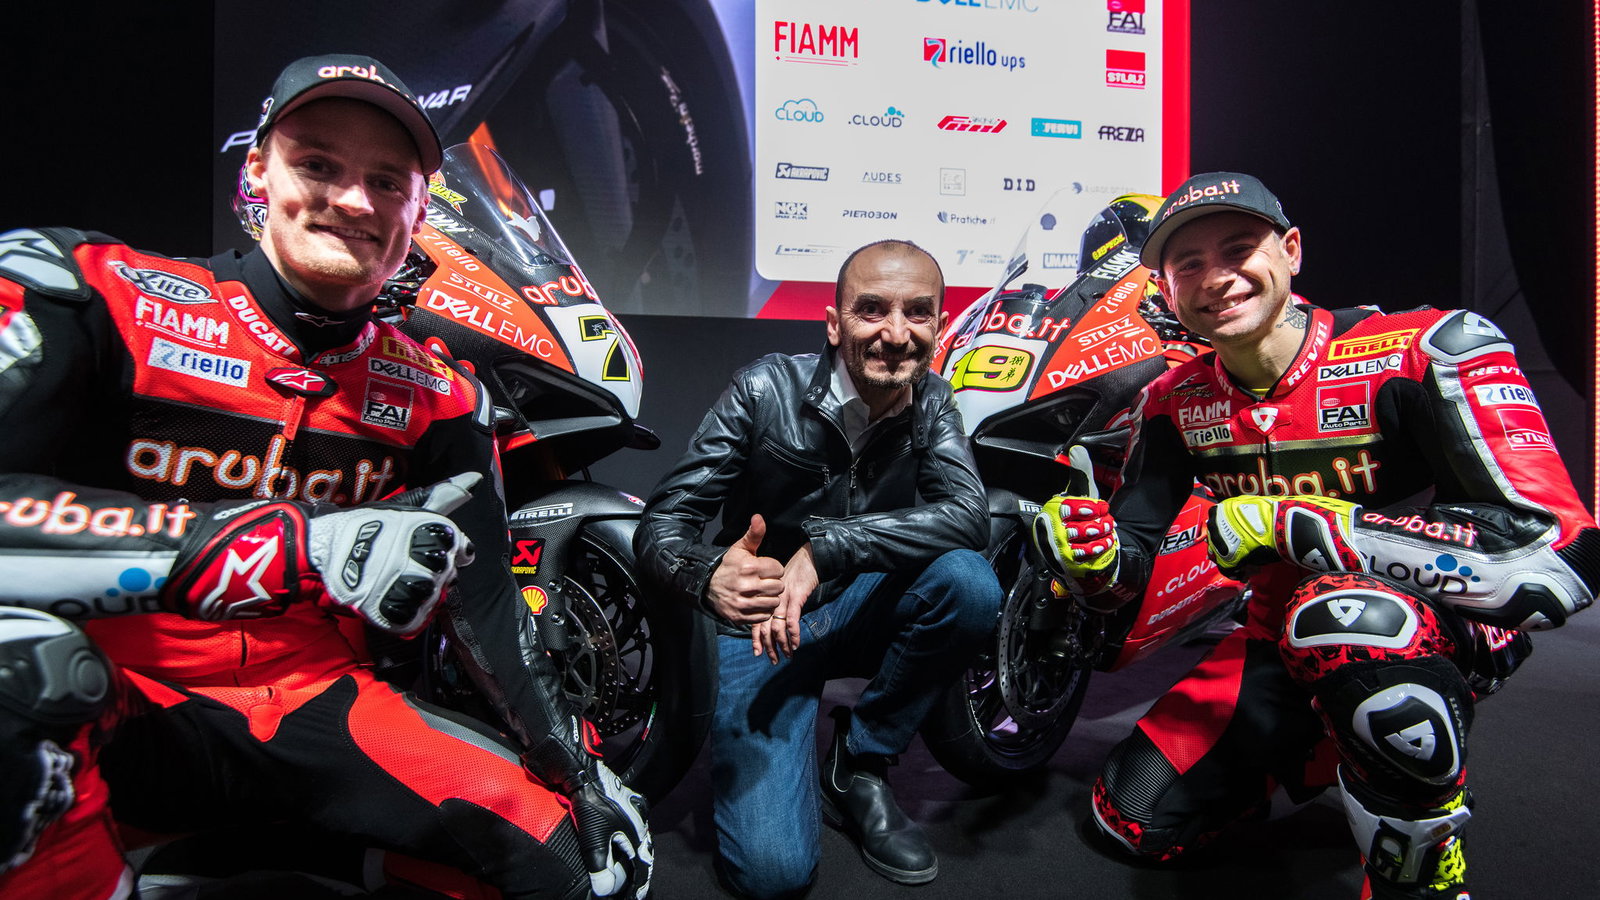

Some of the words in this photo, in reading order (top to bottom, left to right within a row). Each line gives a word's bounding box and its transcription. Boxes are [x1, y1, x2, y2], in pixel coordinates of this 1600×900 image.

[775, 21, 859, 58] FIAMM
[949, 40, 997, 66] riello
[1001, 56, 1025, 72] ups
[775, 107, 824, 123] CLOUD
[1098, 125, 1144, 142] FREZZA
[862, 172, 902, 183] AUDES
[843, 210, 898, 219] PIEROBON
[1162, 179, 1241, 220] aruba.it
[434, 240, 480, 272] riello
[449, 272, 515, 310] STULZ
[1110, 281, 1138, 315] riello
[135, 295, 230, 345] FIAMM
[228, 295, 297, 357] DUCATI
[1078, 317, 1135, 347] STULZ
[578, 315, 631, 382] 7
[1333, 331, 1412, 358] PIRELLI
[180, 352, 244, 381] riello
[950, 345, 1035, 393] 19
[365, 402, 408, 421] FAI
[1178, 399, 1231, 425] FIAMM
[1322, 404, 1366, 423] FAI
[1194, 426, 1230, 443] riello
[127, 434, 394, 503] aruba.it
[1204, 450, 1381, 498] aruba.it
[0, 491, 196, 538] uba.it
[511, 503, 573, 520] PIRELLI
[1163, 527, 1197, 548] FAI
[1361, 512, 1479, 548] aruba.it
[1157, 559, 1217, 597] .CLOU
